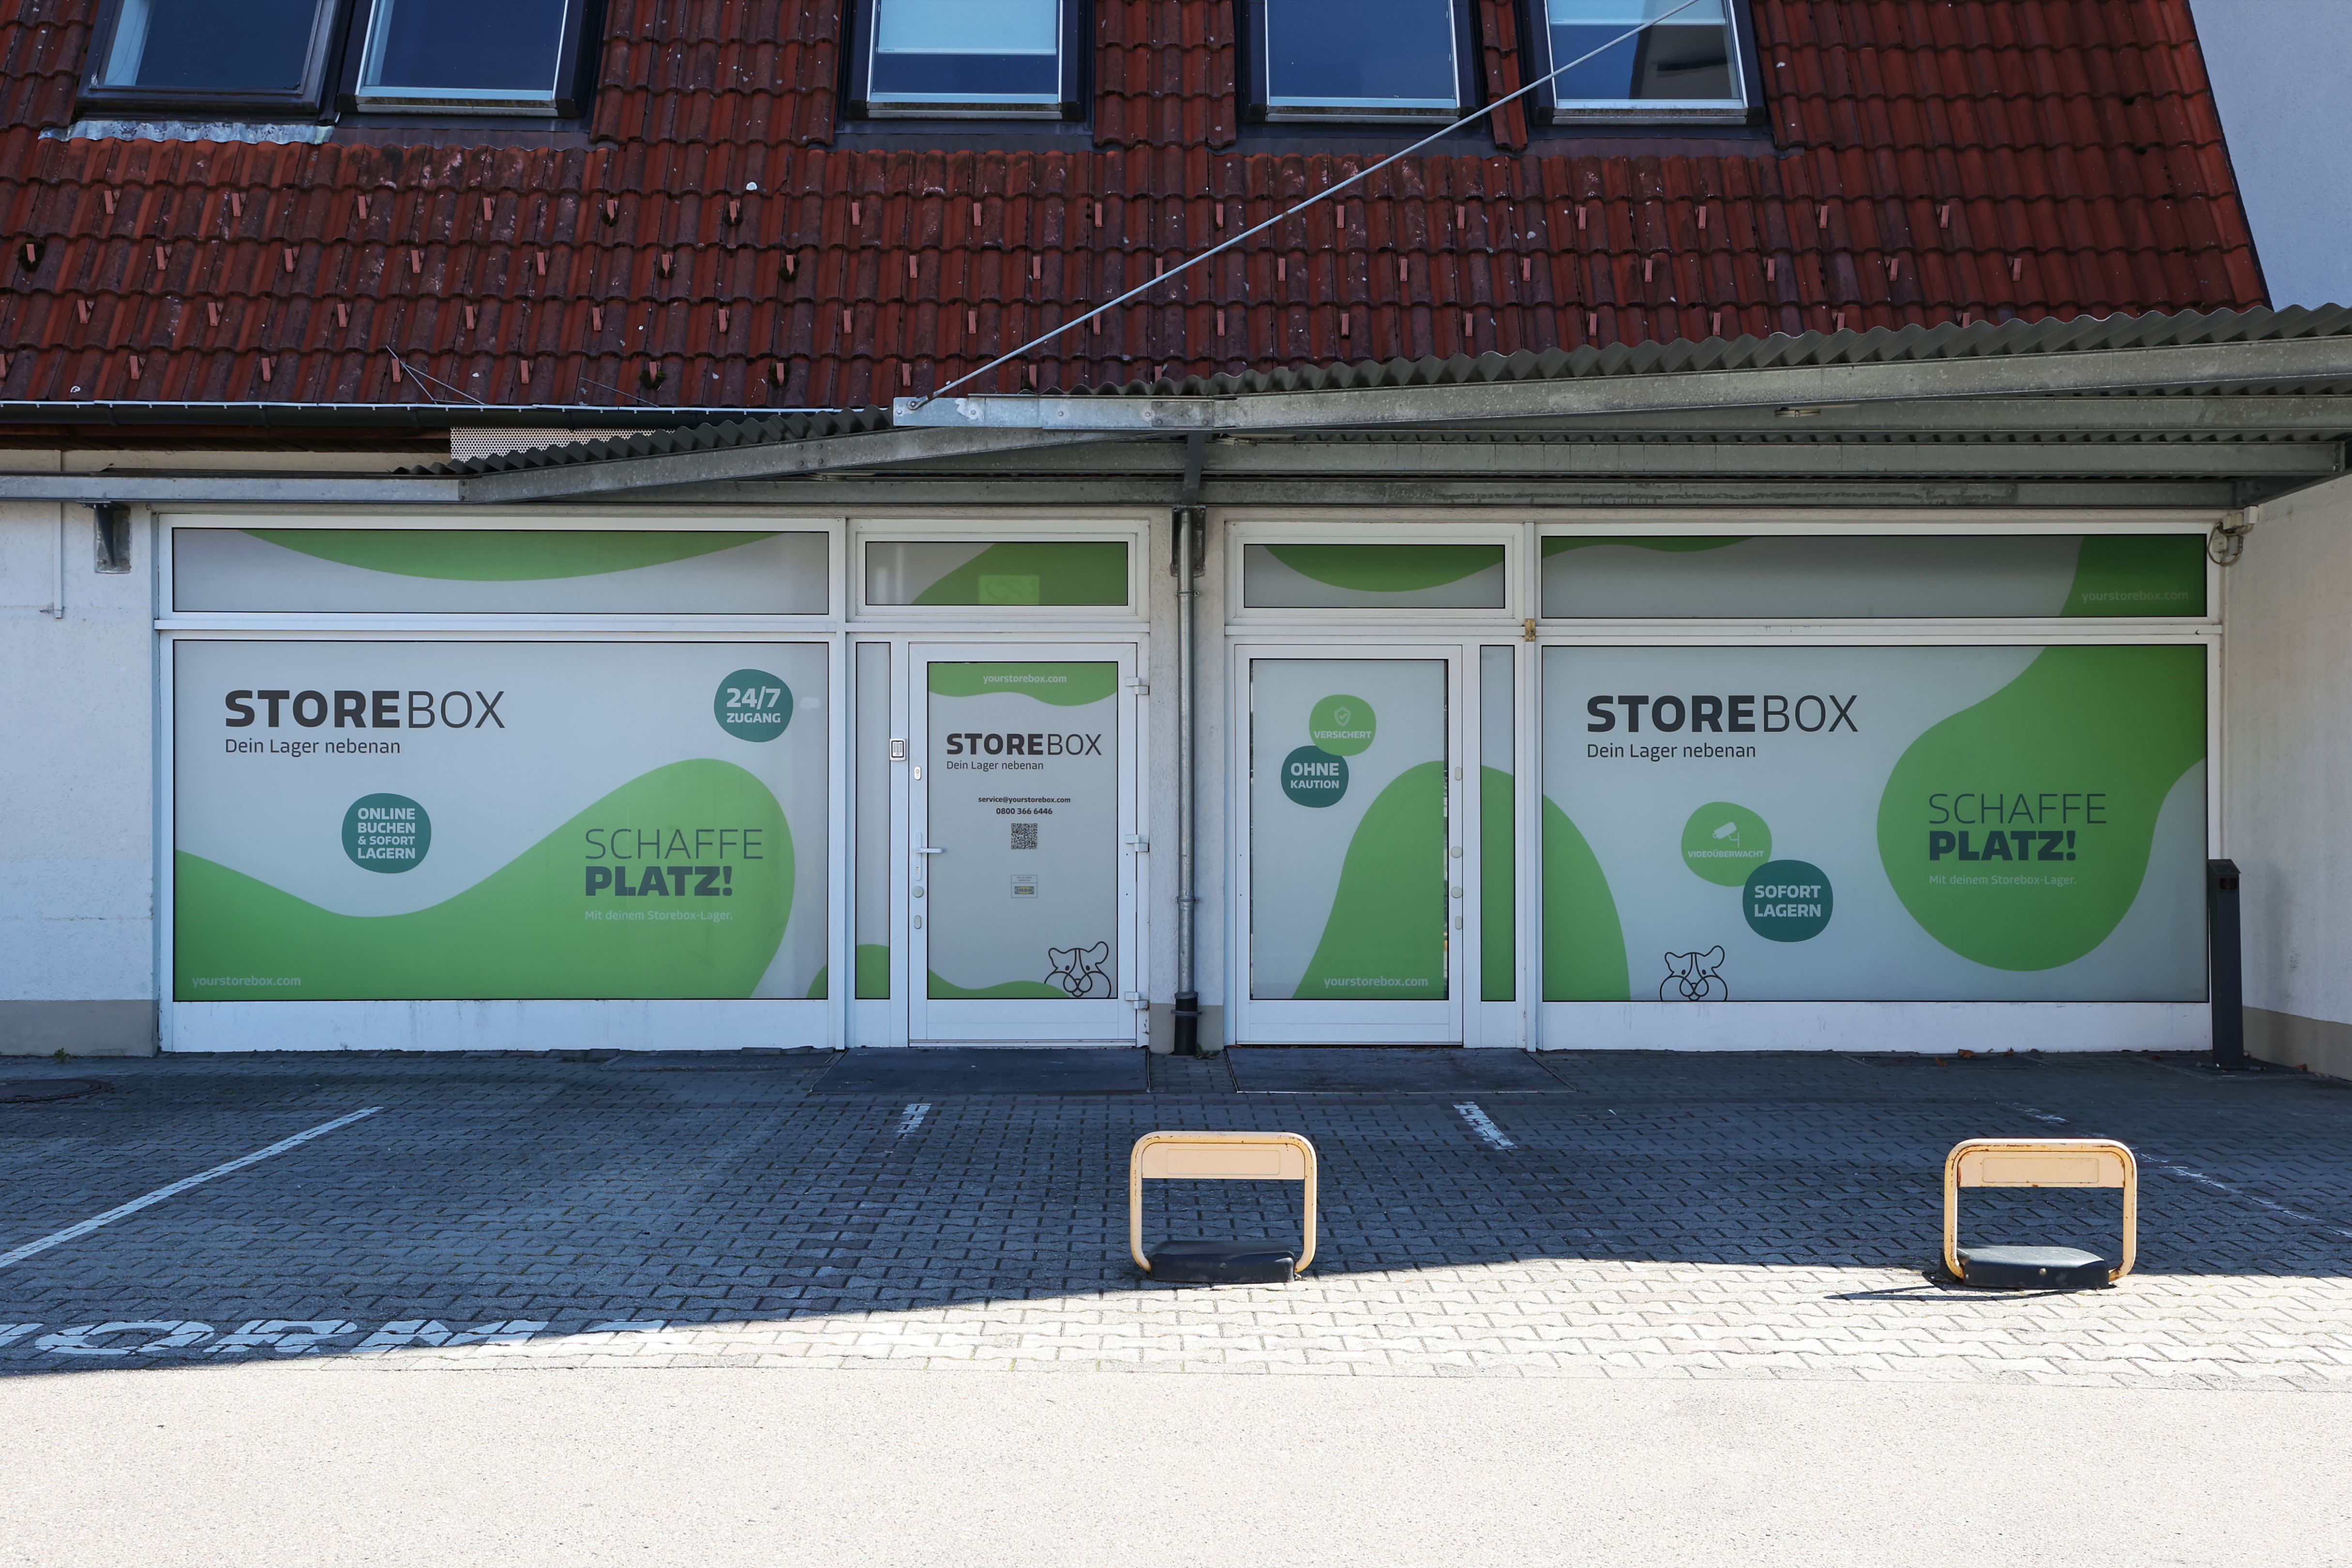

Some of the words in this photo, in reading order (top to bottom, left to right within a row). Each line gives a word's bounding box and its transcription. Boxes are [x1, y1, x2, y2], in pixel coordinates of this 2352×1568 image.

[2082, 590, 2188, 604] yourstorebox.com
[983, 674, 1067, 684] yourstorebox.com
[726, 686, 781, 710] 24/7
[225, 690, 506, 729] STOREBOX
[1586, 694, 1859, 733] STOREBOX
[726, 713, 781, 724] ZUGANG
[1313, 731, 1372, 739] VERSICHERT
[225, 739, 264, 754] Dein
[270, 739, 319, 757] Lager
[325, 738, 401, 754] nebenan
[946, 733, 1102, 756] STOREBOX
[1587, 743, 1625, 758] Dein
[1630, 743, 1678, 763] Lager
[1683, 743, 1756, 758] nebenan
[947, 761, 968, 769] Dein
[971, 761, 999, 772] Lager
[1001, 761, 1044, 770] nebenan
[1290, 762, 1340, 776] OHNE
[1290, 780, 1340, 789] KAUTION
[357, 807, 416, 820] ONLINE
[1929, 793, 2107, 824] SCHAFFE
[357, 822, 416, 834] BUCHEN
[358, 835, 366, 845] &
[369, 835, 416, 845] SOFORT
[585, 828, 764, 859] SCHAFFE
[1929, 829, 2076, 861] PLATZ!
[357, 847, 416, 859] LAGERN
[1688, 849, 1764, 858] VIDEOÜBERWACHT
[585, 865, 733, 896] PLATZ!
[1929, 875, 1947, 885] Mit
[1949, 875, 1989, 885] deinem
[1991, 875, 2077, 887] Storebox-Lager.
[1754, 885, 1822, 899] SOFORT
[585, 911, 603, 920] Mit
[605, 911, 645, 920] deinem
[647, 910, 733, 922] Storebox-Lager.
[1754, 904, 1822, 917] LAGERN
[192, 976, 302, 989] yourstorebox.com
[1324, 976, 1429, 989] yourstorebox.com
